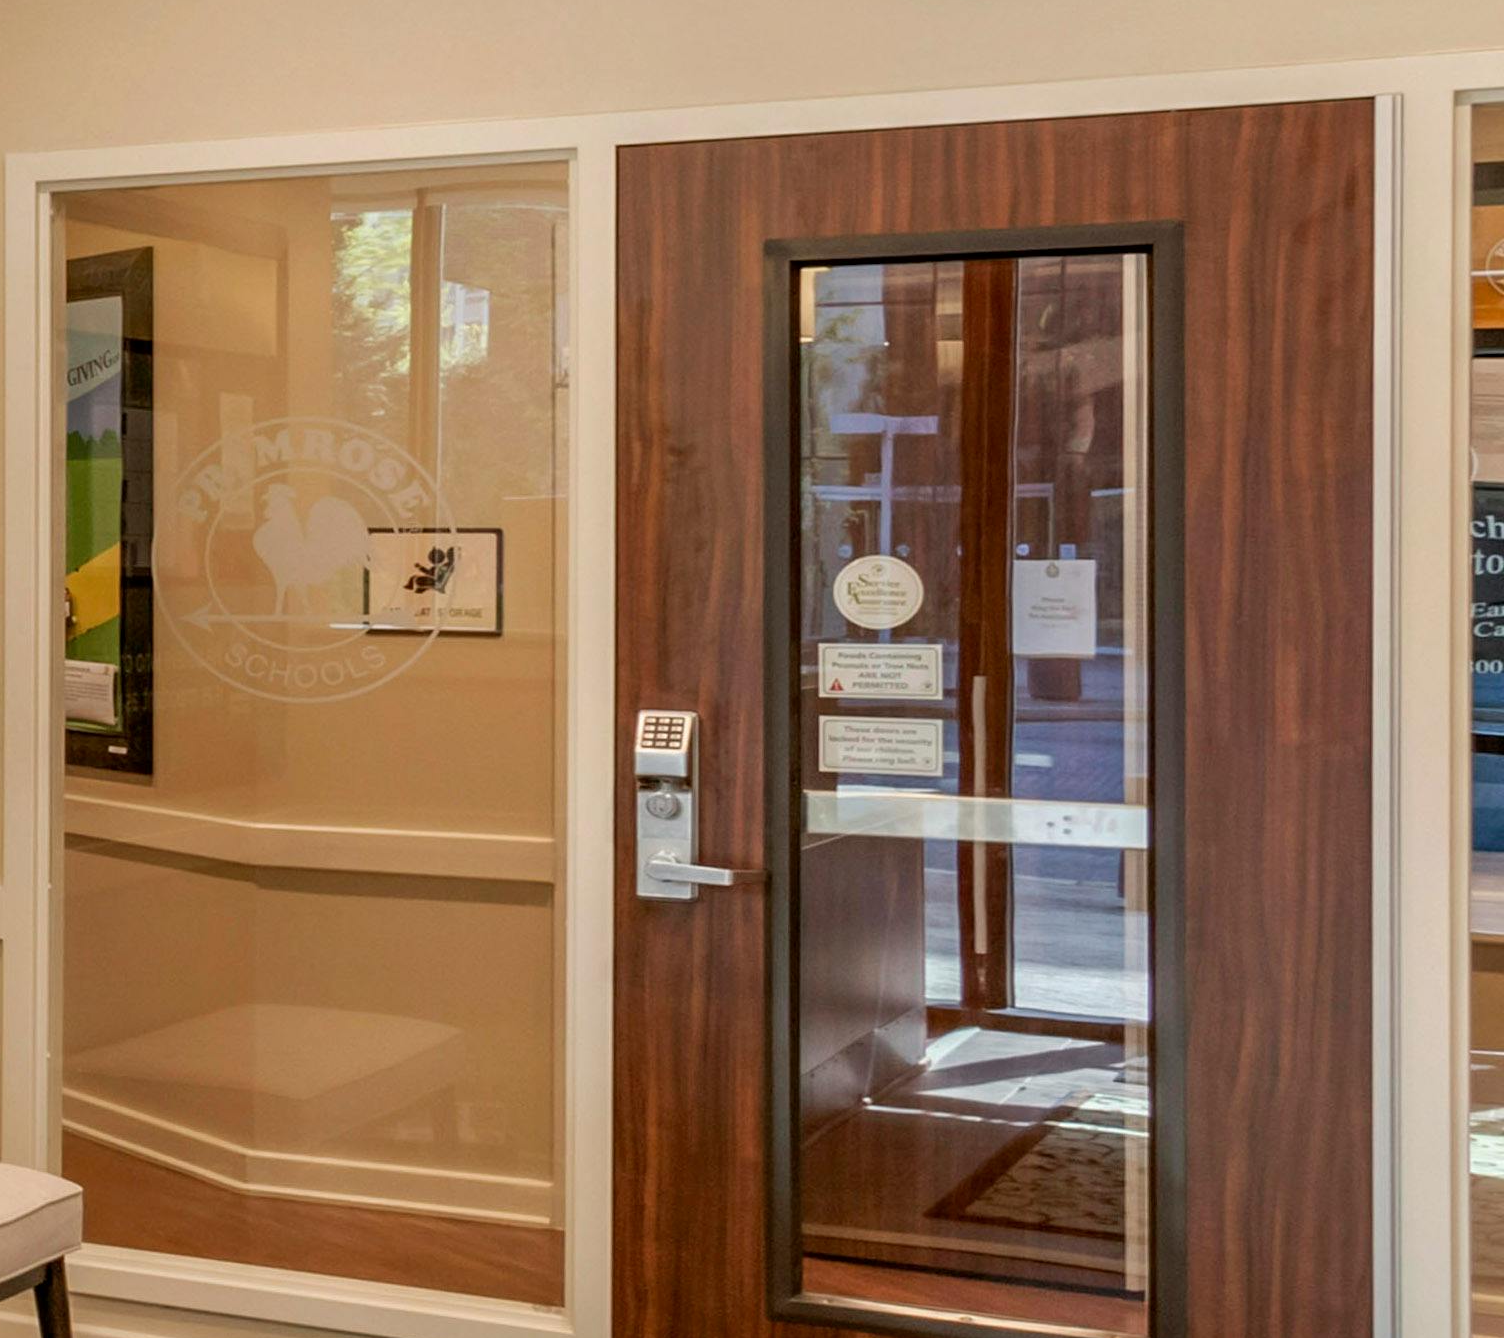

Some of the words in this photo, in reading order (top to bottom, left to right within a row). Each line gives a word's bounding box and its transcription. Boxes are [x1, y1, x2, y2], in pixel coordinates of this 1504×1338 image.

[178, 428, 430, 522] PRMROSE
[225, 642, 386, 688] SCHOOLS
[852, 682, 909, 690] PERMITTED
